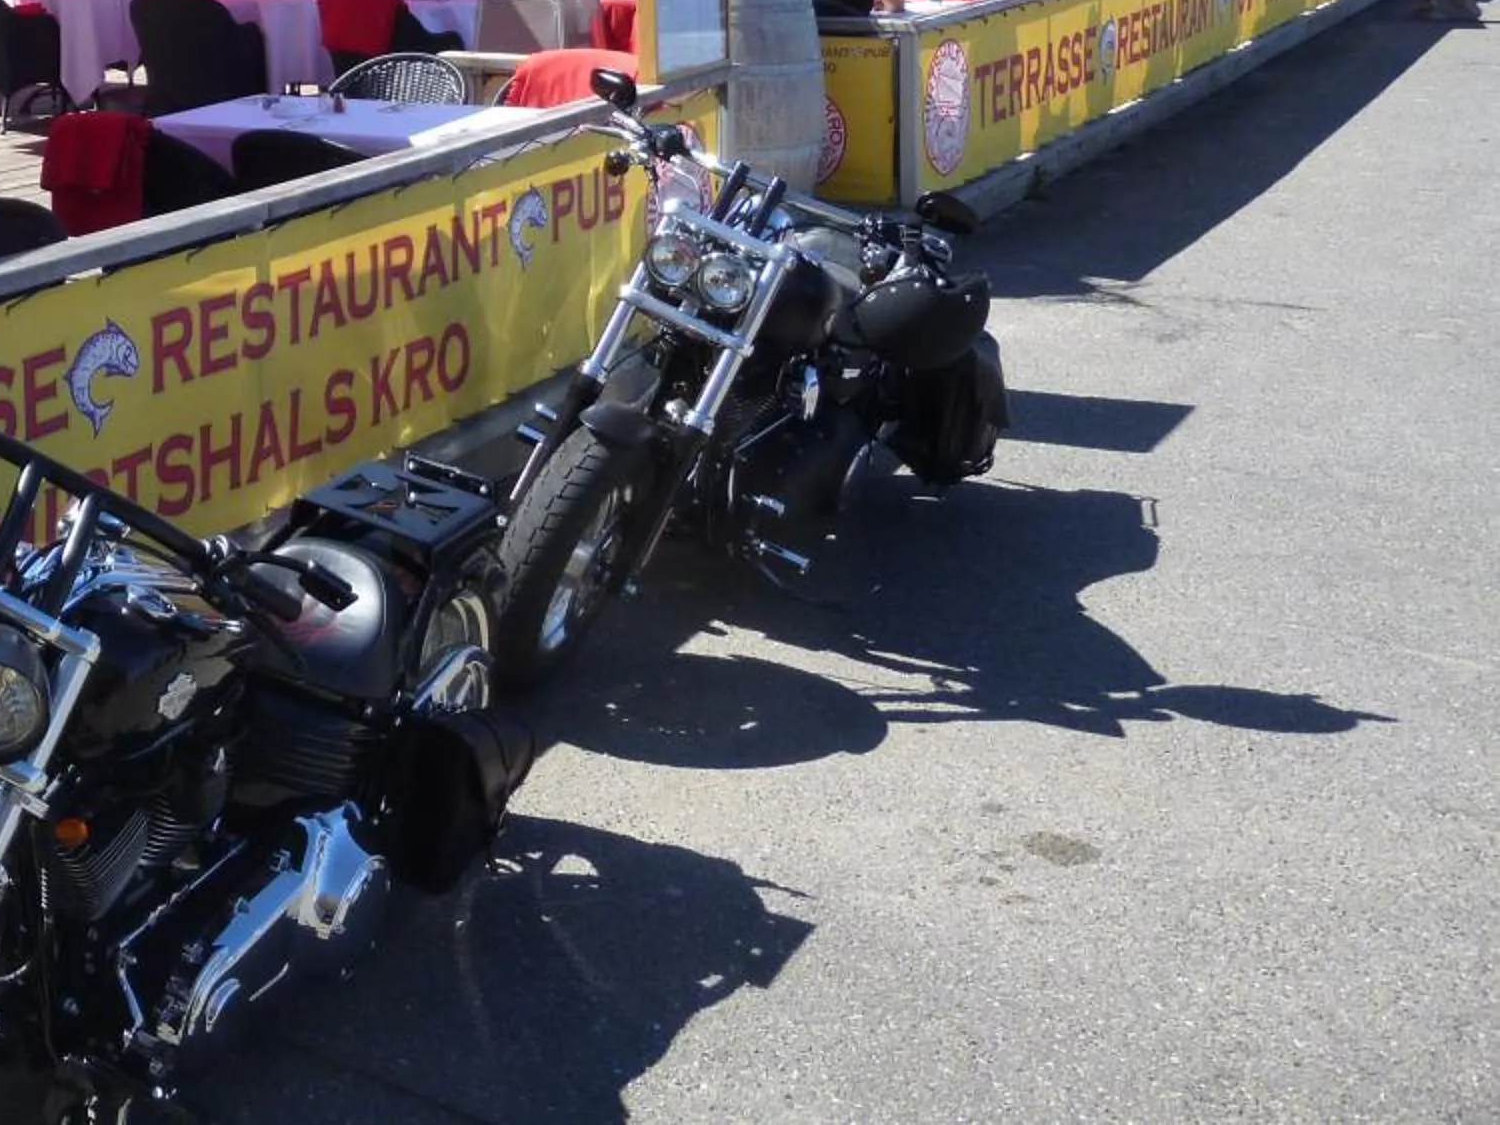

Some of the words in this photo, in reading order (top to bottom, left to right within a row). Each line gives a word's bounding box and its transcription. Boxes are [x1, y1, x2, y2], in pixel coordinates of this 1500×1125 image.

[974, 26, 1097, 131] TERRASSE
[150, 198, 507, 394] RESTAURANT
[551, 165, 626, 244] PUB
[371, 322, 471, 428] KRO
